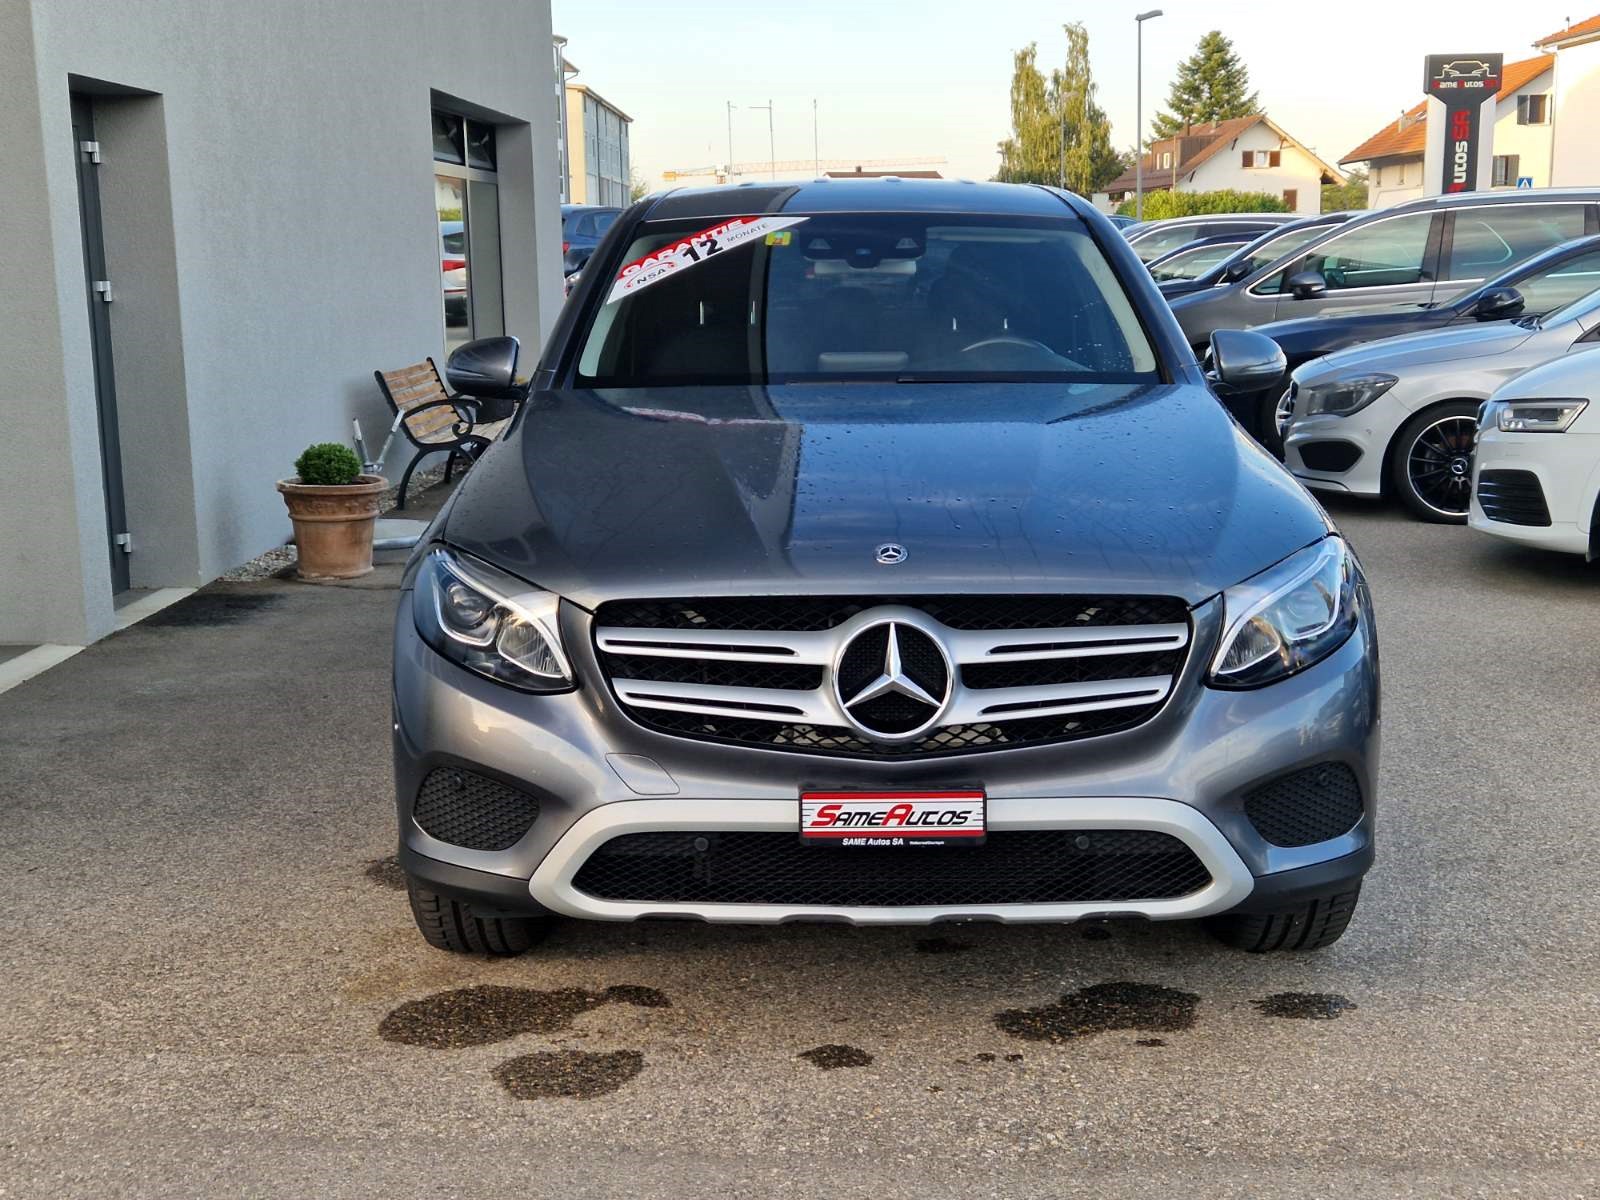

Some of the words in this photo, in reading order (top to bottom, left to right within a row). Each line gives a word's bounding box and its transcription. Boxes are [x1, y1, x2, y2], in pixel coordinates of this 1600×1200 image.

[726, 222, 768, 243] MONATE
[682, 238, 724, 262] 12
[636, 268, 666, 285] NSA
[842, 838, 866, 846] SAME
[867, 838, 890, 846] Autos
[892, 838, 904, 846] SA
